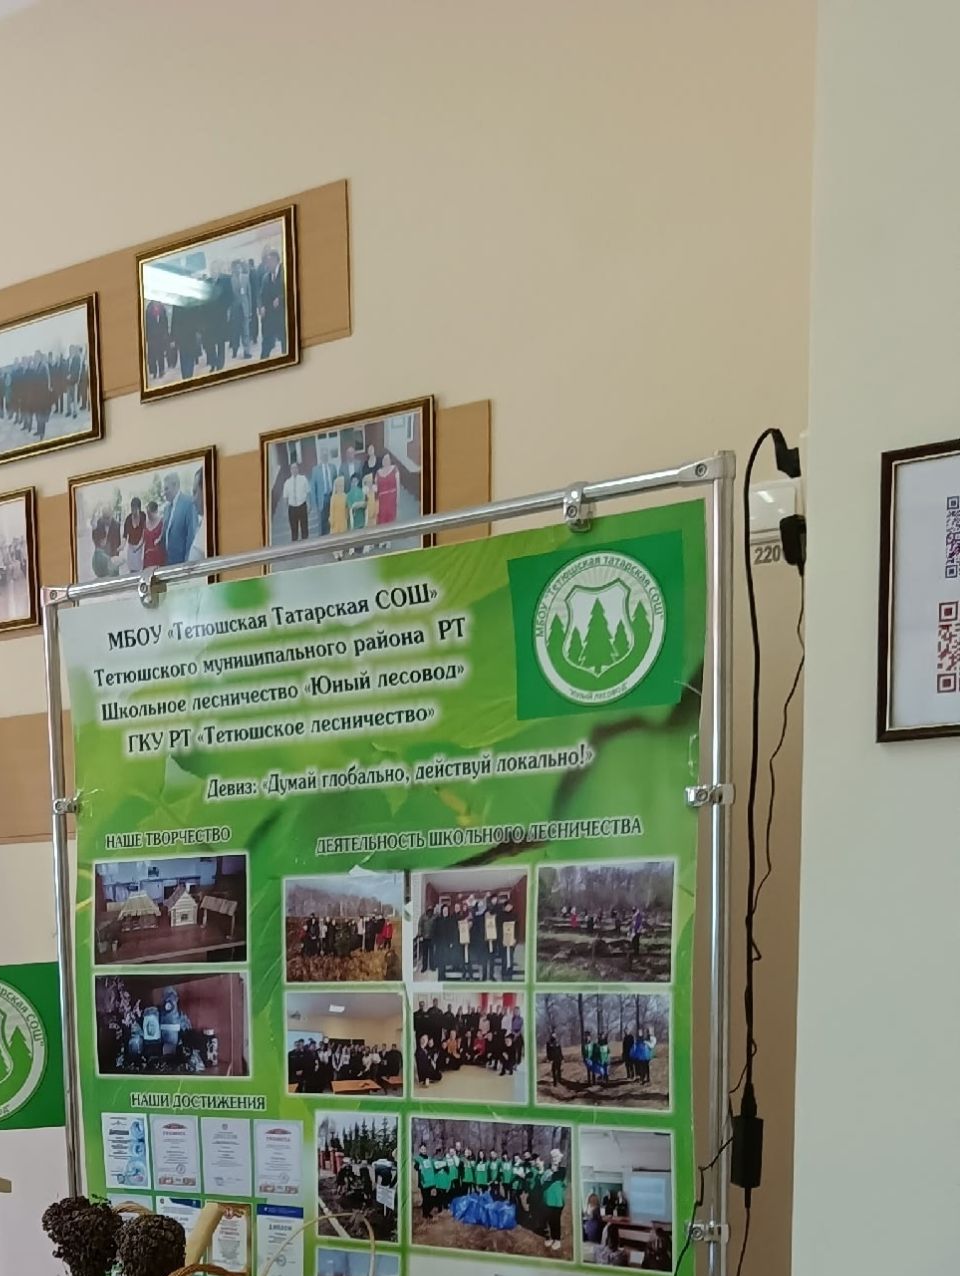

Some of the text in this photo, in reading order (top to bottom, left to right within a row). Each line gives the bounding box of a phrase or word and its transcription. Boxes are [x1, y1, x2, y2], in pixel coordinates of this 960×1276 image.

[754, 544, 781, 565] 220
[108, 582, 437, 651] МБОУ «Тетюшская Татарская СОШ»
[94, 616, 467, 688] Тетюшского муниципального района РТ
[101, 662, 465, 722] Школьное лесничество «Юный лесовод»
[128, 706, 436, 753] ГКУ РТ «Тетюшское лесничество»
[207, 743, 592, 799] Девиз: «Думай глобально, действуй локально!»
[105, 826, 231, 850] НАШЕ ТВОРЧЕСТВО
[316, 817, 642, 856] ДЕЯТЕЛЬНОСТЬ ШКОЛЬНОГО ЛЕСНИЧЕСТВА
[131, 1093, 266, 1110] НАШИ ДОСТИЖЕНИЯ
